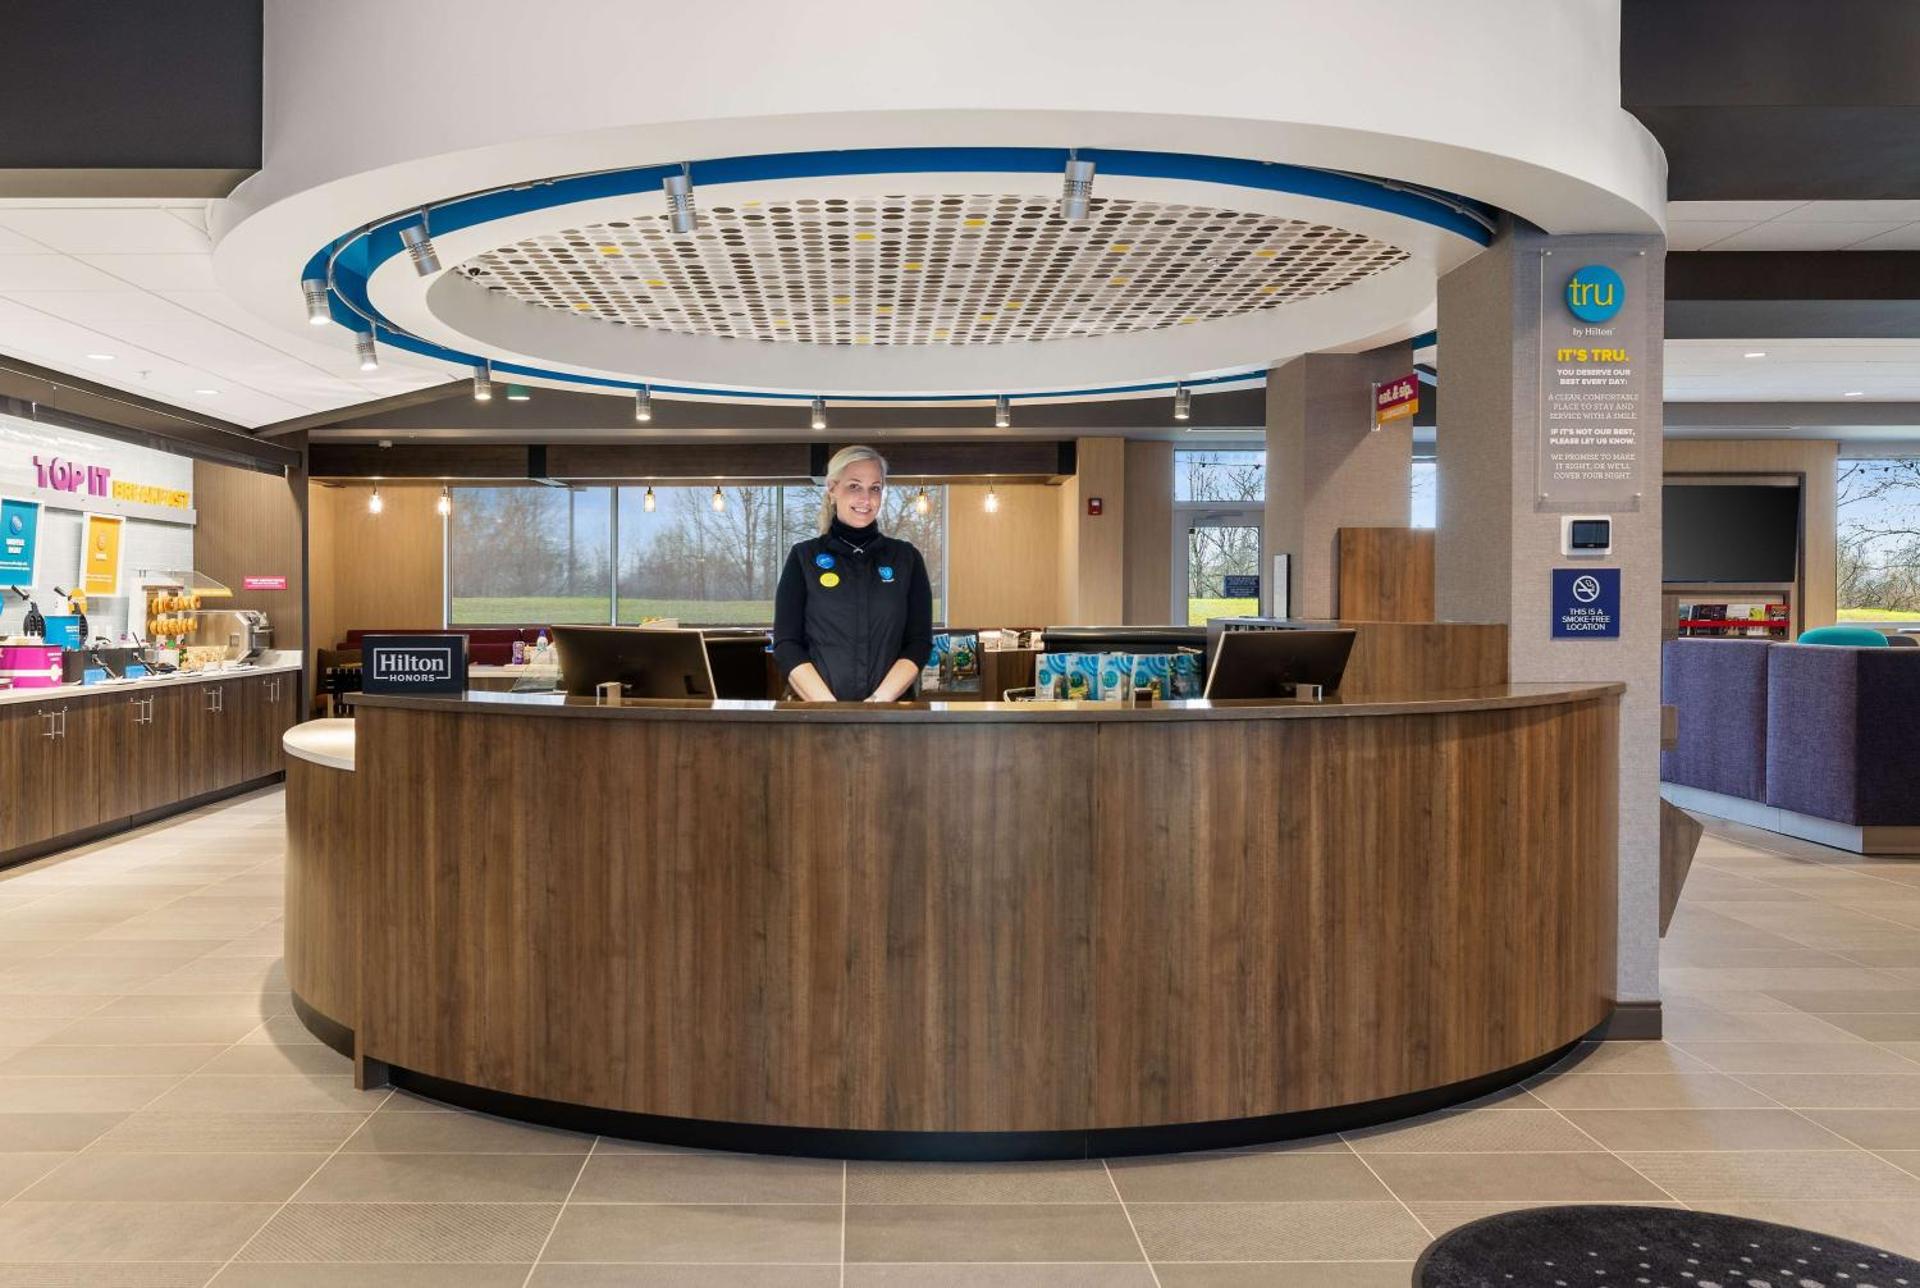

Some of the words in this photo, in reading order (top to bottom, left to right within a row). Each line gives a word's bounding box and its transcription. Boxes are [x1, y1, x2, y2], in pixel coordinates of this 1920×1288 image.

[1569, 278, 1613, 306] tru
[1573, 327, 1583, 337] by
[1557, 348, 1588, 362] IT'S
[1591, 348, 1629, 362] TRU.
[1392, 385, 1399, 400] &
[1553, 403, 1579, 411] PLACE
[1581, 403, 1592, 411] TO
[1593, 403, 1614, 411] STAY
[1616, 403, 1634, 411] AND
[1549, 437, 1579, 445] PLEASE
[1581, 437, 1595, 445] LET
[1596, 437, 1607, 445] US
[32, 455, 85, 492] TOP
[87, 465, 111, 497] IT
[1553, 471, 1581, 480] COVER
[1582, 471, 1603, 480] YOUR
[1562, 615, 1611, 623] SMOKE-FREE
[1566, 623, 1606, 631] LOCATION
[380, 653, 444, 671] Hilton
[389, 674, 435, 682] HONORS
